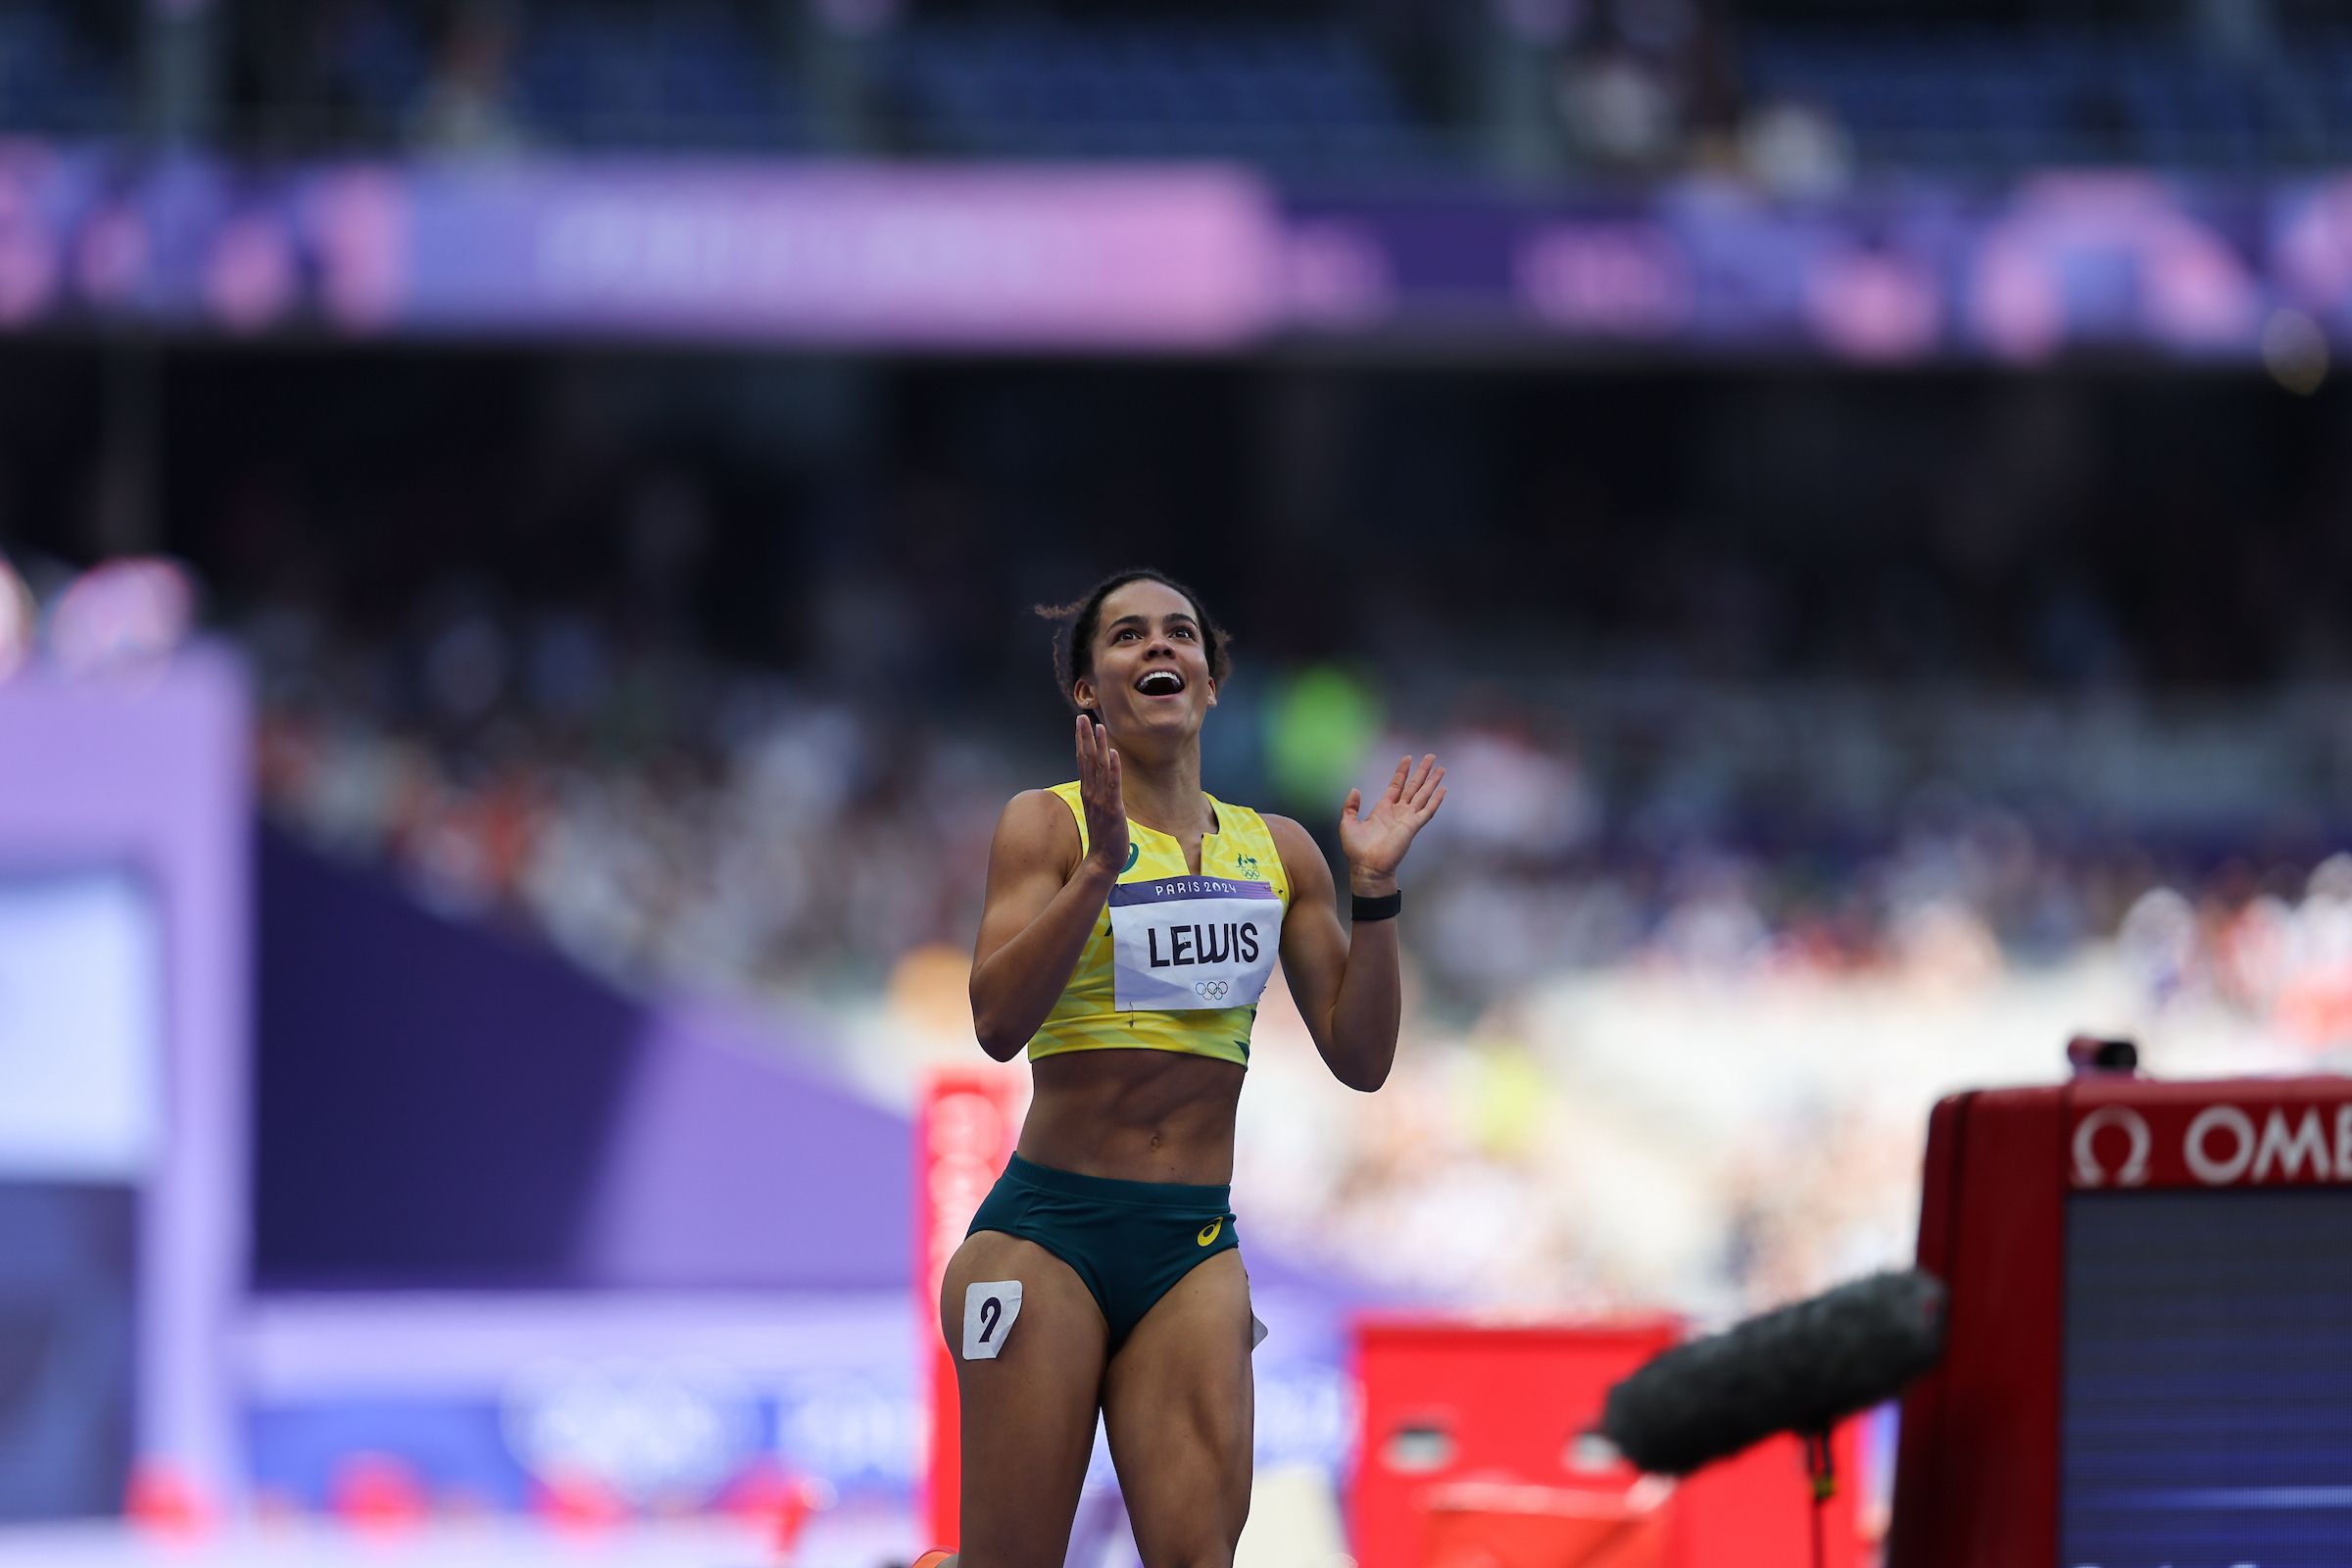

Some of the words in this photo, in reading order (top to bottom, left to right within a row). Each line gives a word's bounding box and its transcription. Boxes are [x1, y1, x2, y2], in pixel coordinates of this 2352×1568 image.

[1155, 881, 1200, 896] PARIS
[1203, 881, 1237, 894] 2024
[1148, 922, 1259, 967] LEWIS
